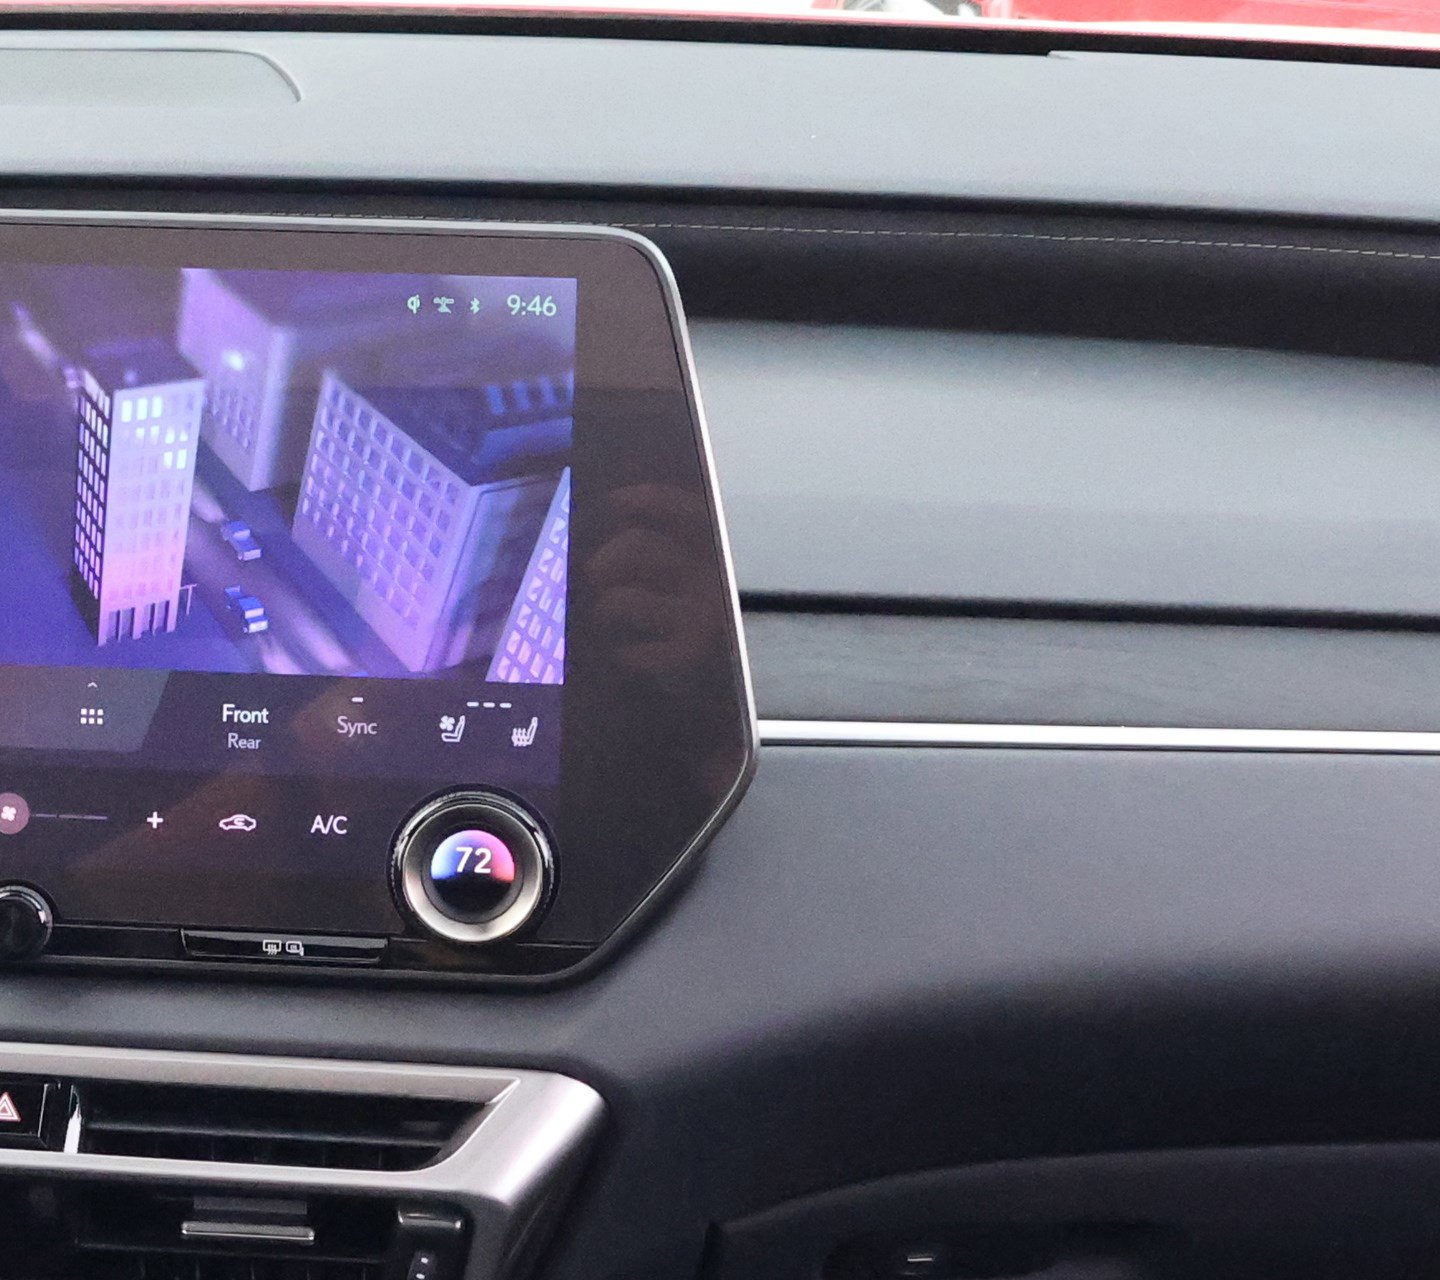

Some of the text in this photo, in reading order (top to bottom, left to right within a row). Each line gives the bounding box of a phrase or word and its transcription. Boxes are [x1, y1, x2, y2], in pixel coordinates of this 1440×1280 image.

[506, 294, 557, 317] 9:46
[222, 703, 270, 725] Front
[337, 715, 379, 736] Sync
[227, 732, 262, 750] Rear
[310, 815, 349, 835] A/C
[455, 846, 492, 874] 72
